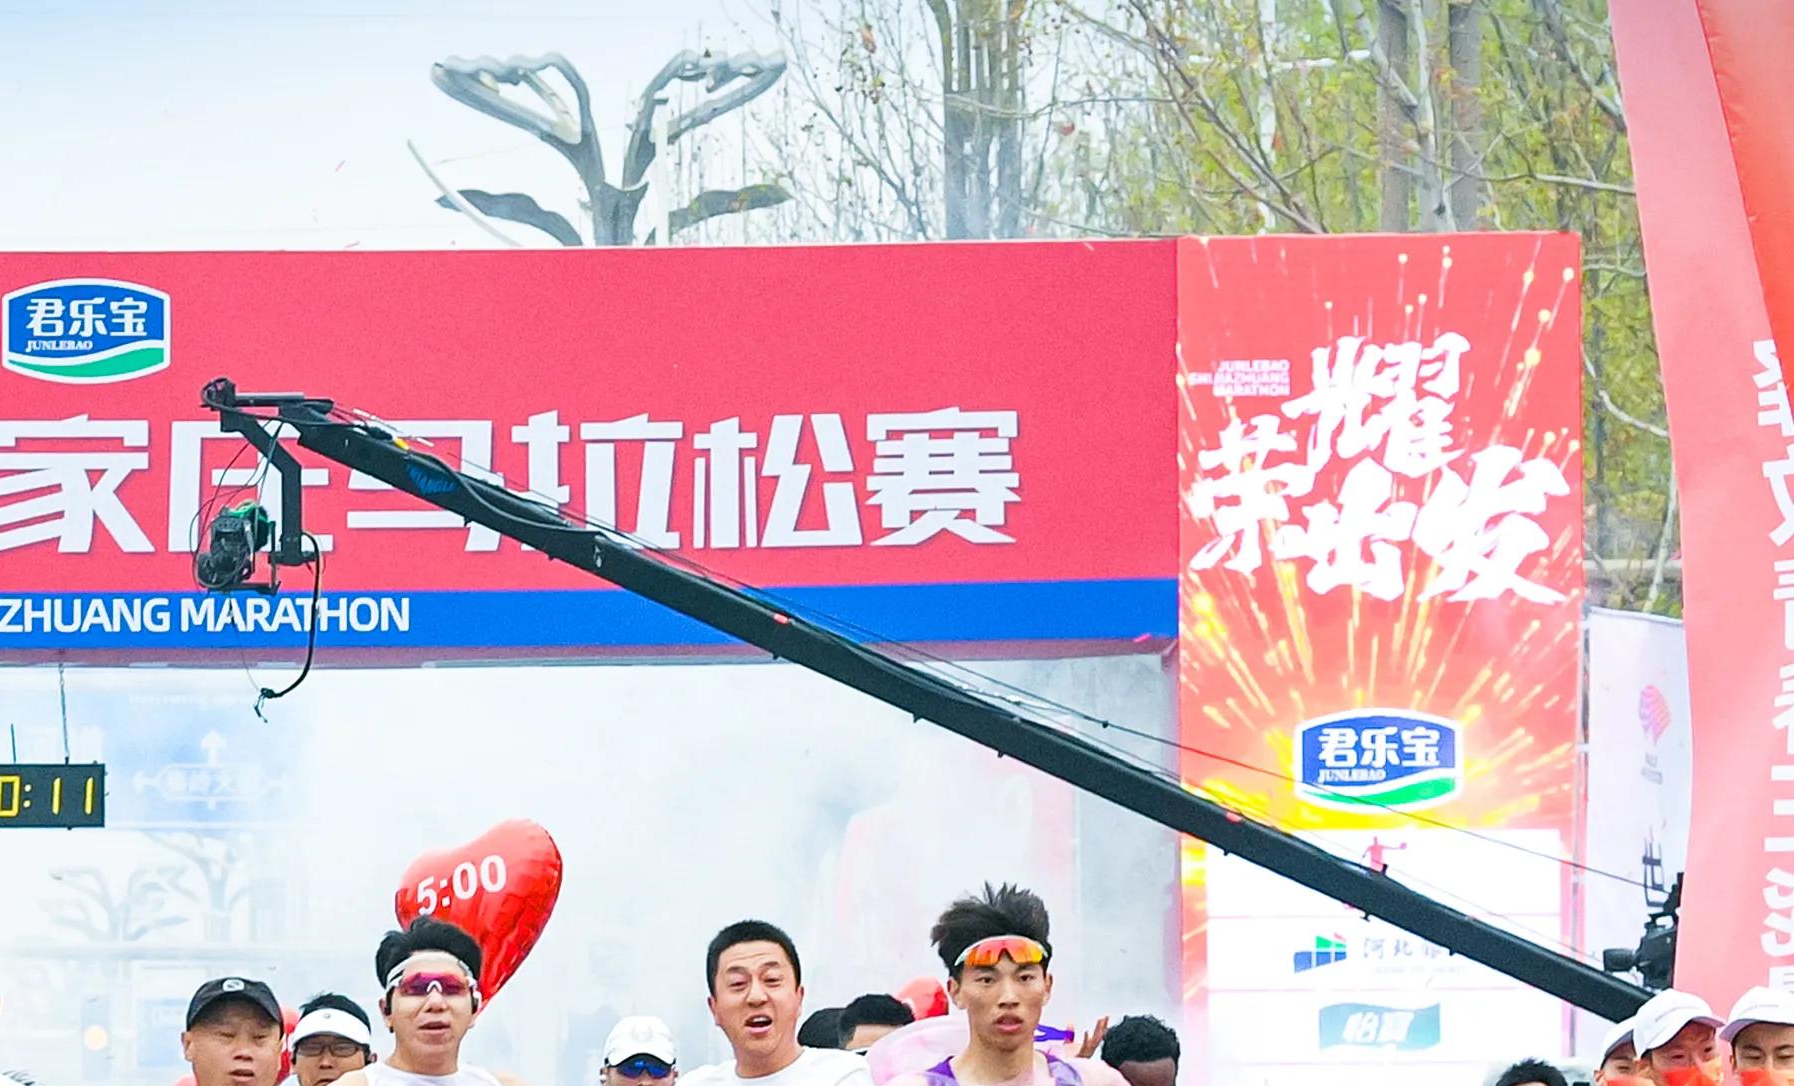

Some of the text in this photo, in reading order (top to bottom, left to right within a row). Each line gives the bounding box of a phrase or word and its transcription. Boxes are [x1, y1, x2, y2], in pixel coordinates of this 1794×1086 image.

[25, 296, 149, 339] 君乐宝
[25, 341, 94, 353] JUNLEBAO
[179, 597, 410, 632] MARATHON
[1317, 725, 1442, 768] 君乐宝
[1317, 768, 1388, 784] JUNLEBAO
[415, 854, 507, 918] 5:00
